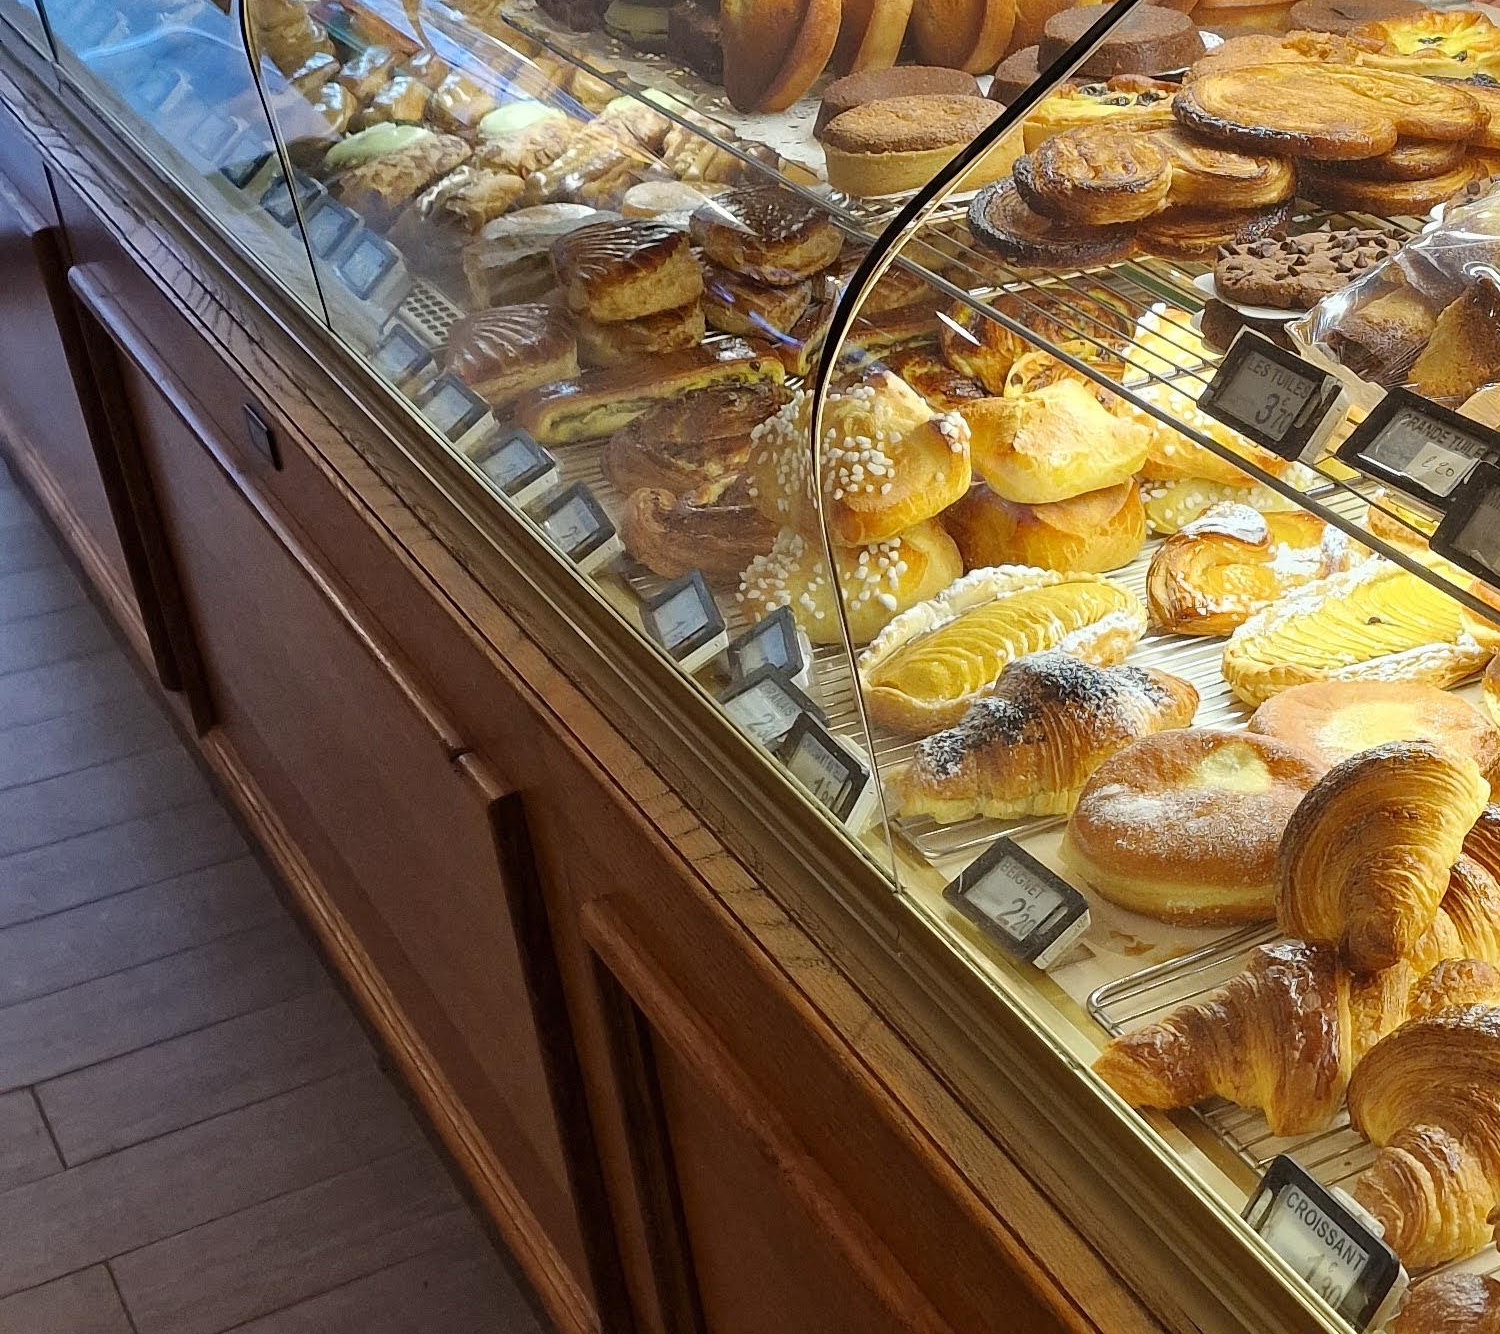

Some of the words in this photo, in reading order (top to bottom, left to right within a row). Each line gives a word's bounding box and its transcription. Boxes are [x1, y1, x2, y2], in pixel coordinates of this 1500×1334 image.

[1246, 356, 1271, 378] LES
[1271, 369, 1312, 399] TUILES
[1400, 413, 1451, 444] GRANDE
[999, 861, 1045, 899] BEIGNET
[1286, 1191, 1366, 1271] CROISSANT
